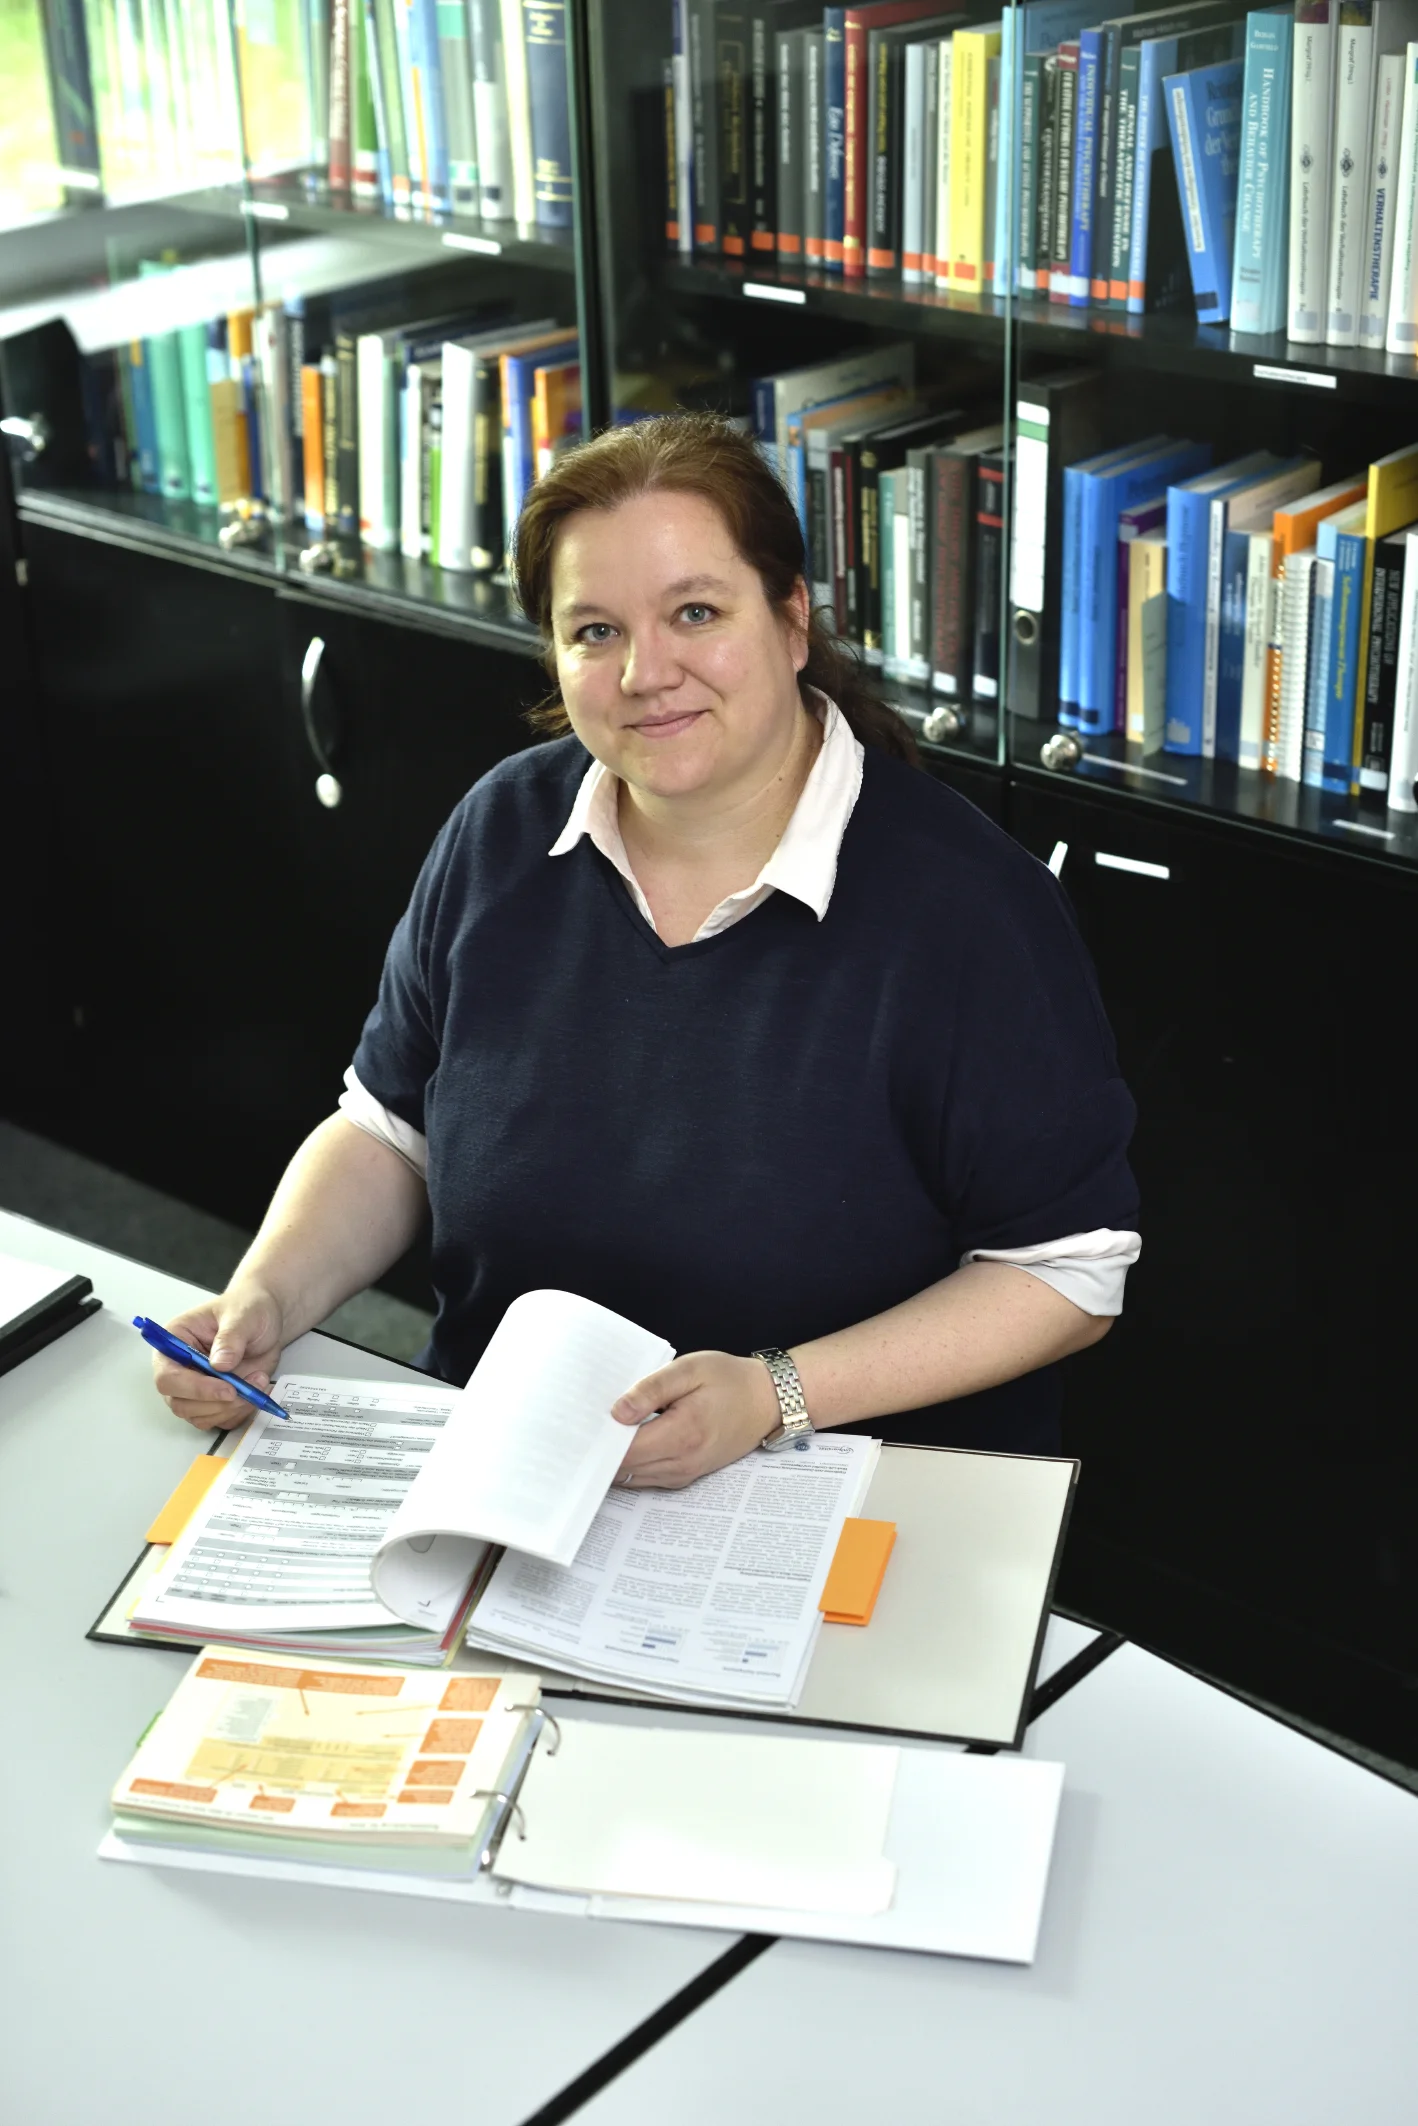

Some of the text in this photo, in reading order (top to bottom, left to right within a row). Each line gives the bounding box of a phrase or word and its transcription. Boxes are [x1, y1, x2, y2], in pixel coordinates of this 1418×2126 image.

[1084, 63, 1097, 133] INDIVIDUAL
[1118, 88, 1128, 115] THE
[1260, 67, 1275, 137] HANDBOOK
[1124, 152, 1135, 180] AND
[1240, 91, 1258, 232] AND BEHAVIOR CHANGE
[1259, 142, 1269, 156] OF
[1078, 136, 1094, 233] PSYCHOTHERAPY
[1251, 162, 1269, 259] PSYCHOTHERAPY
[1301, 181, 1310, 215] Lehrbuch
[1340, 185, 1349, 219] Lehrbuch
[1369, 187, 1386, 301] VERHALTENSTHERAPIE
[1387, 569, 1401, 590] NEW
[1367, 635, 1383, 704] PSYCHOTHERAPY
